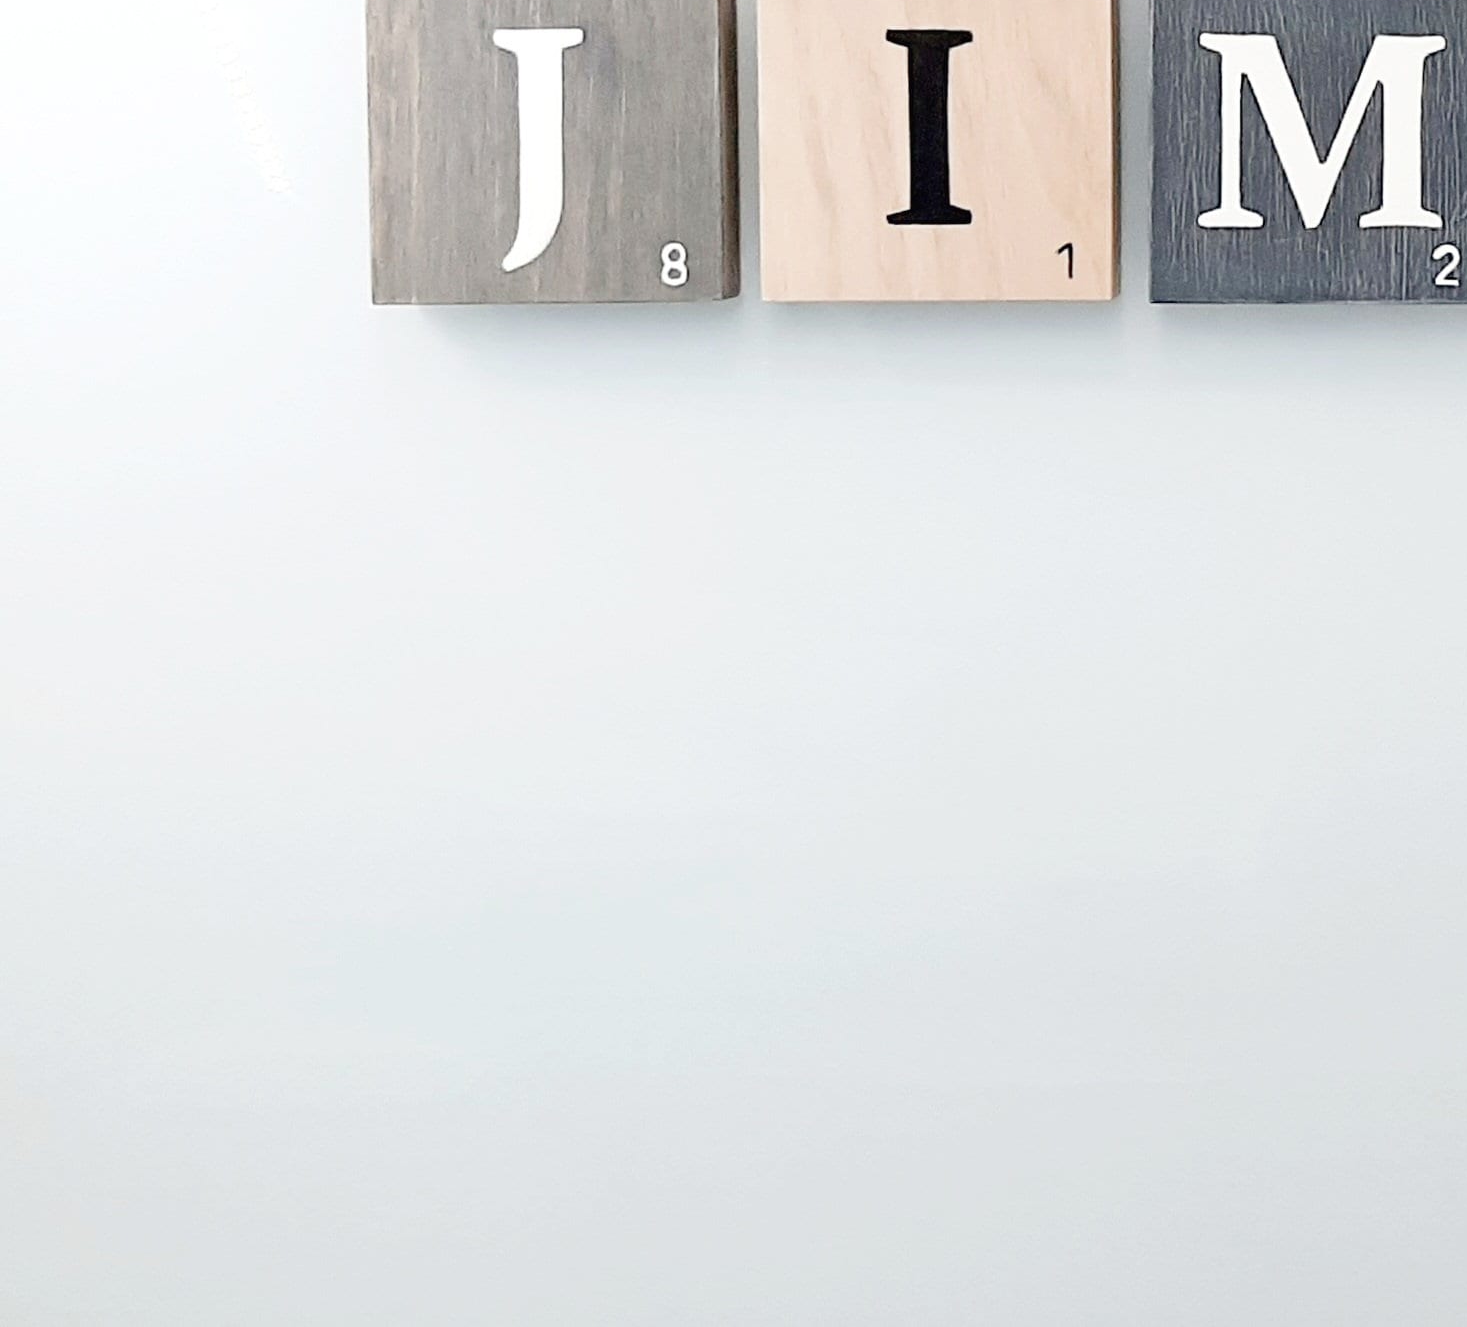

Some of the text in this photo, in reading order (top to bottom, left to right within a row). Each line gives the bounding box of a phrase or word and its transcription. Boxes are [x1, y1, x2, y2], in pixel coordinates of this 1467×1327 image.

[660, 242, 688, 286] 8
[1056, 242, 1074, 279] 1
[1432, 244, 1460, 288] 2
